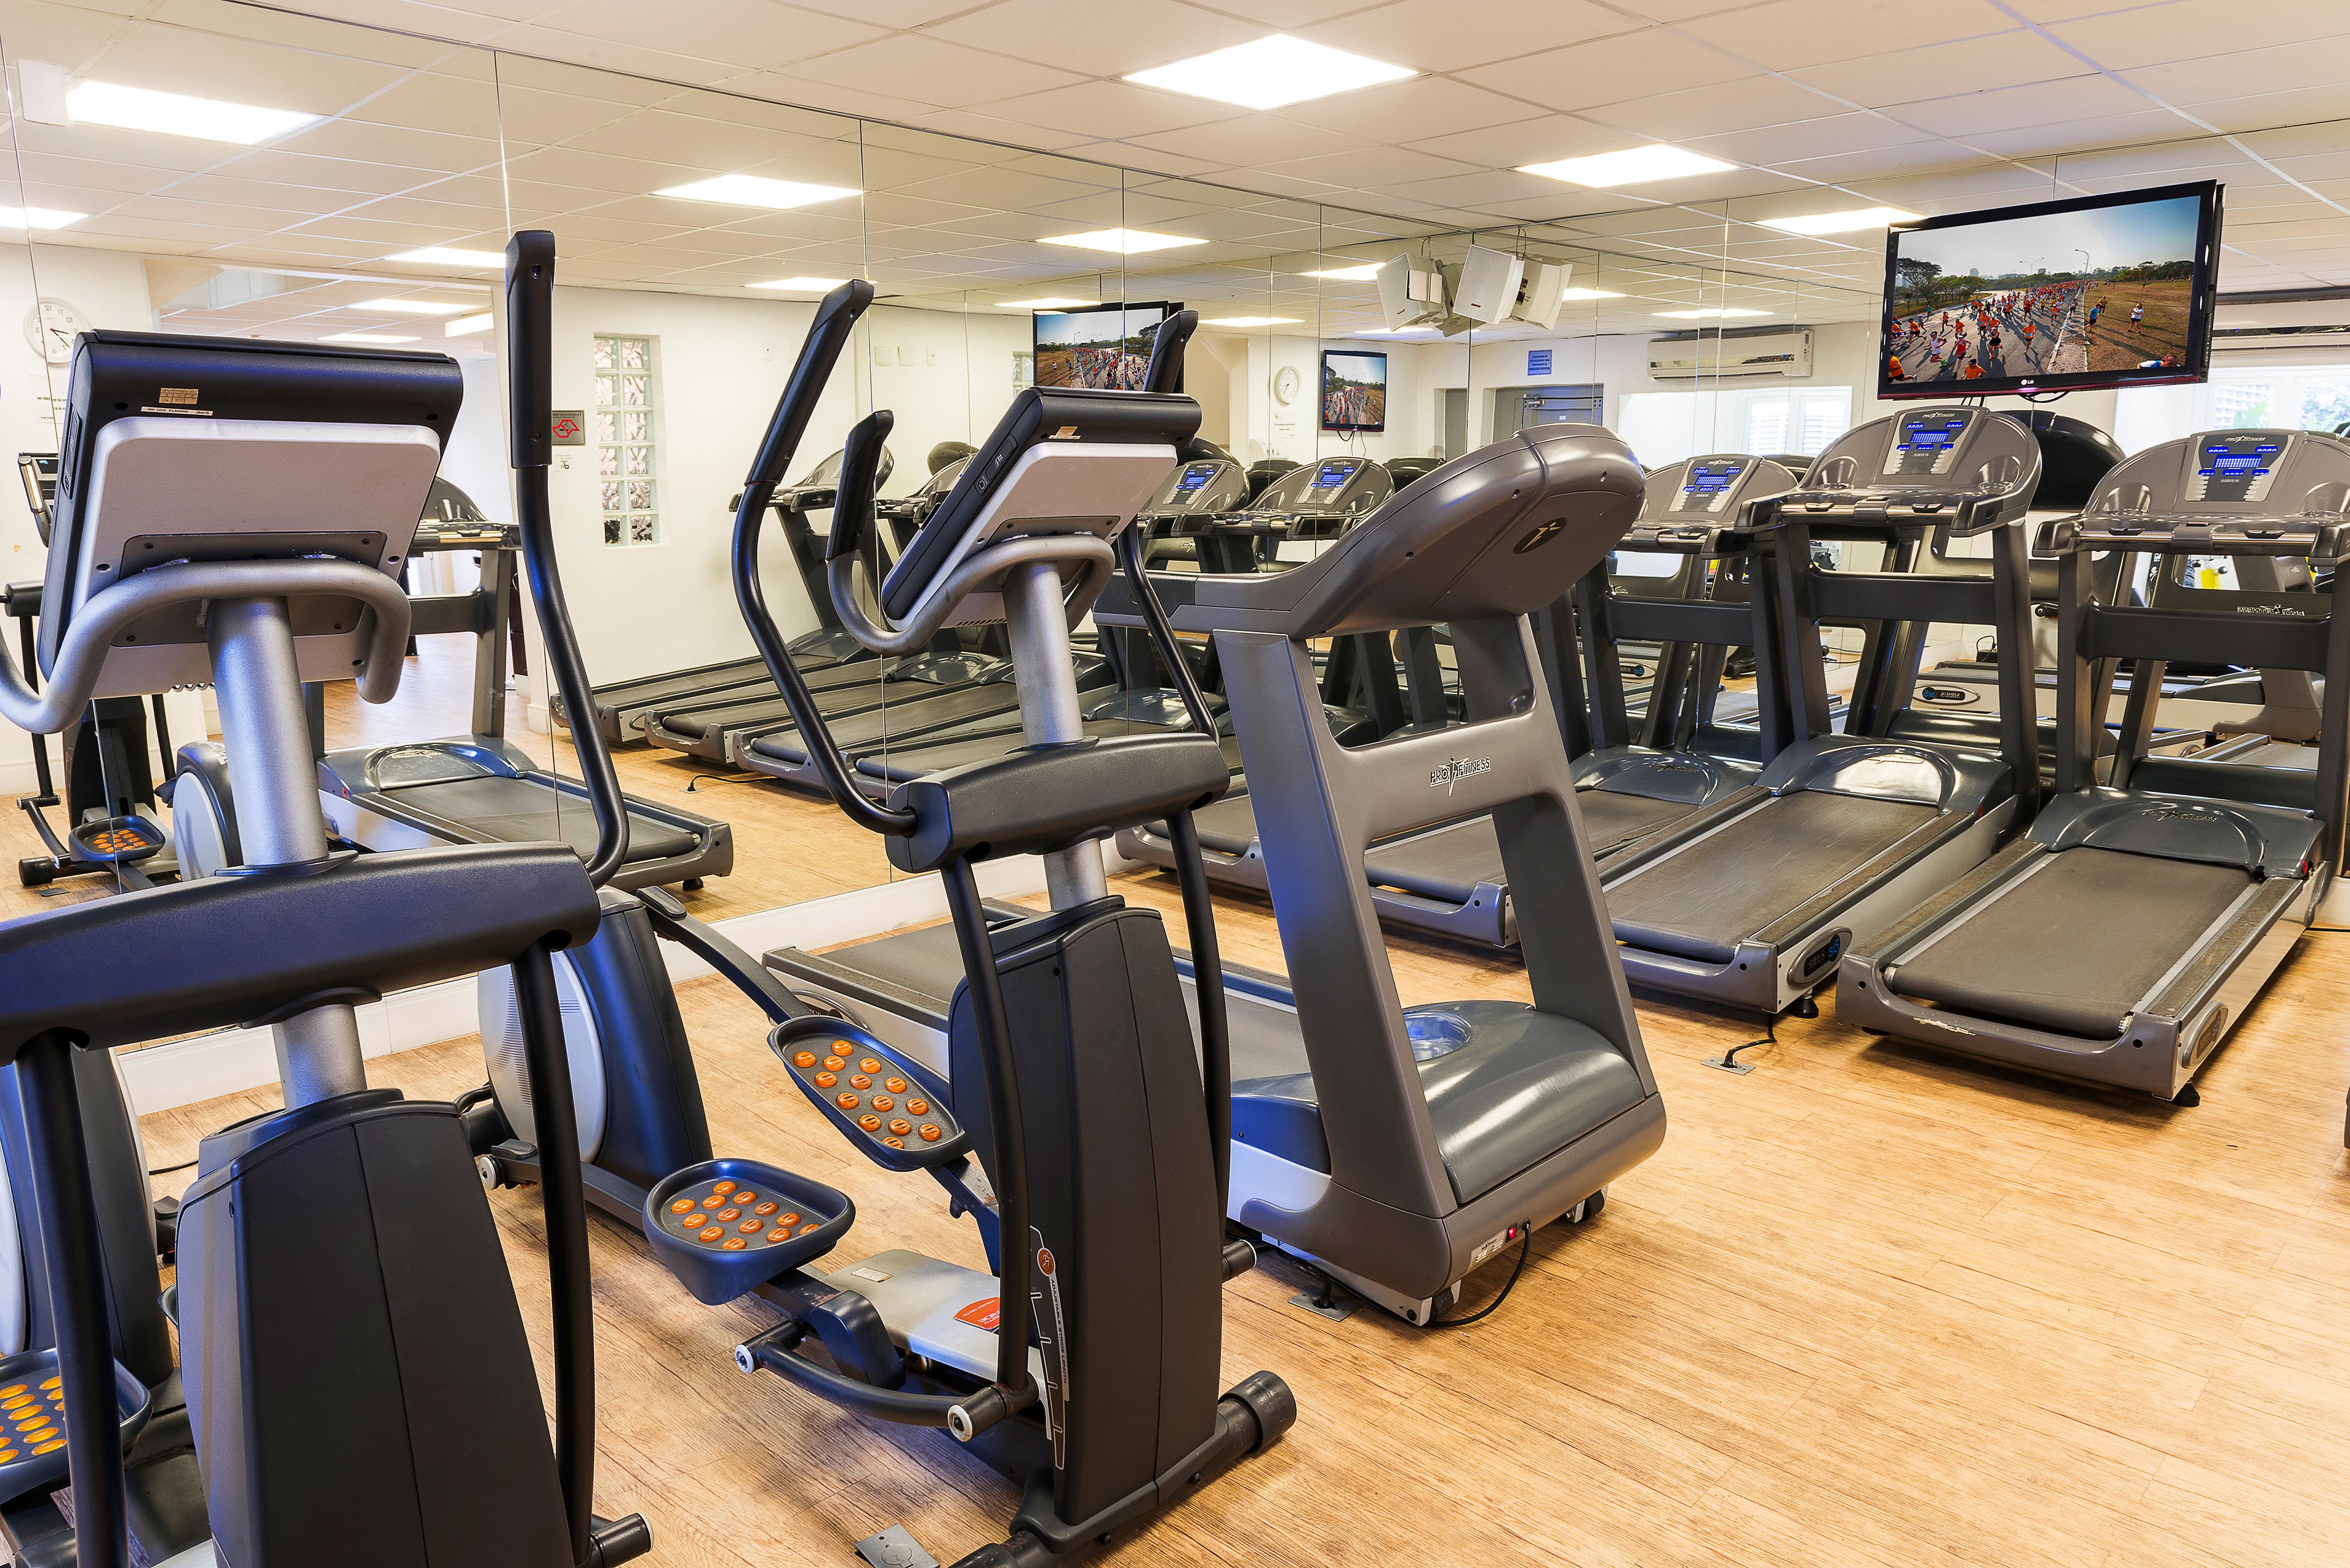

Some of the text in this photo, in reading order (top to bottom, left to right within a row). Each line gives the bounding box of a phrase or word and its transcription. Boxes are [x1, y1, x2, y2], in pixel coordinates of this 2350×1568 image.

[1430, 757, 1490, 783] PRO FITNESS
[1829, 938, 1840, 957] si5
[1051, 1279, 1062, 1325] ADJUSTABLE
